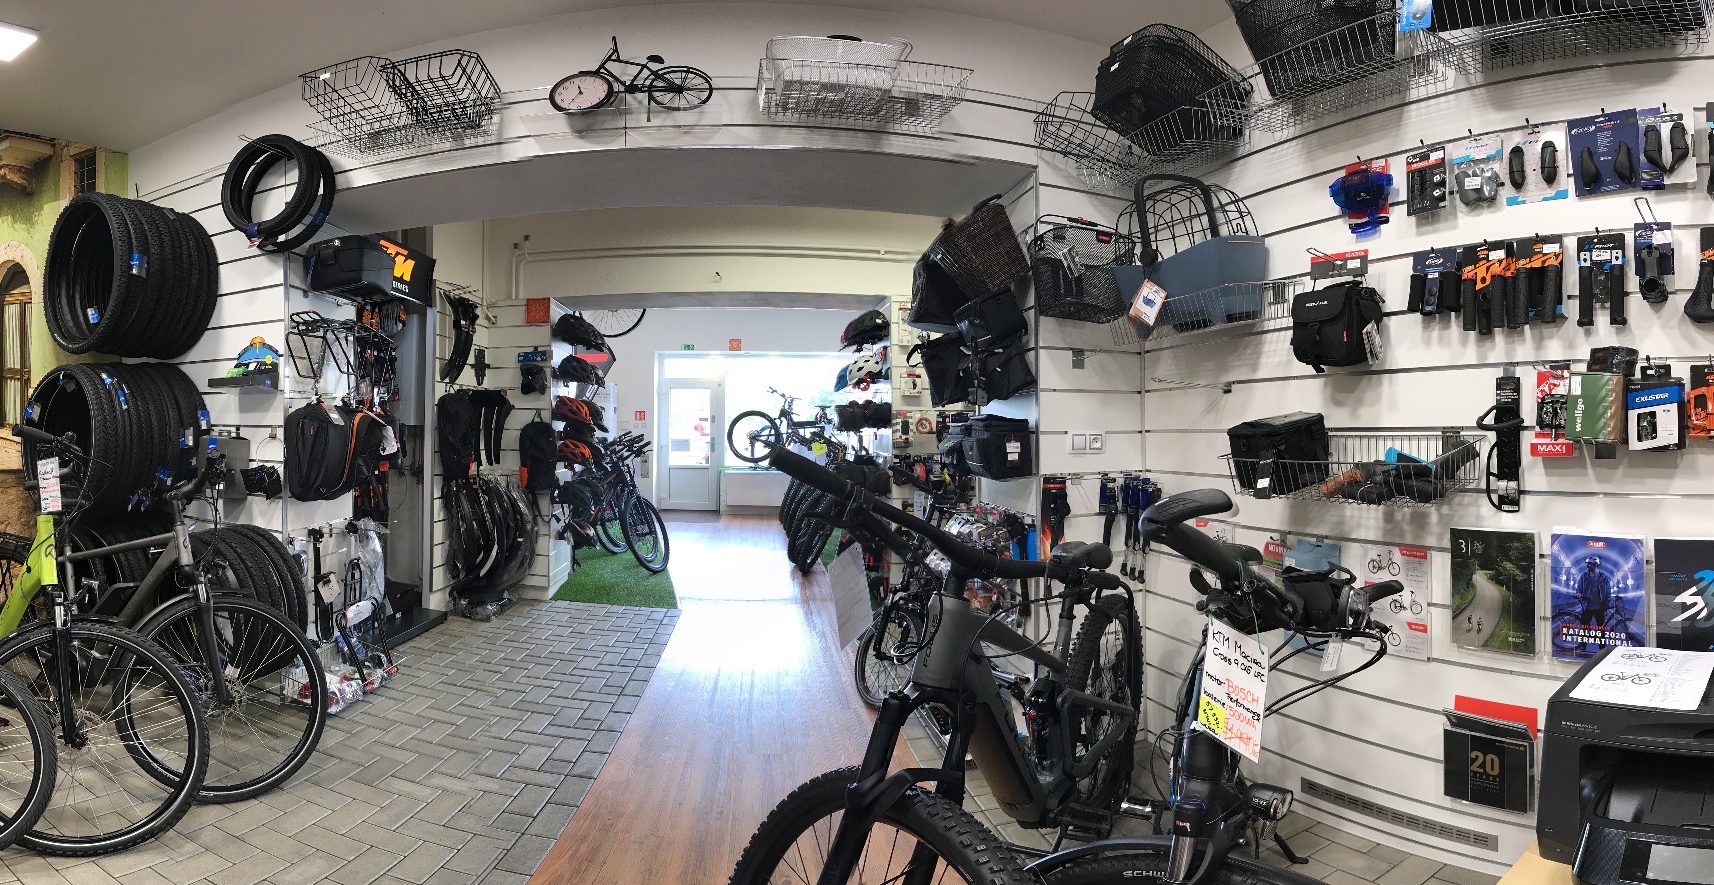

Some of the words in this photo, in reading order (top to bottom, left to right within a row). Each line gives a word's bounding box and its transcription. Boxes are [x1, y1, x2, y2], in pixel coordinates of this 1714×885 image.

[1575, 398, 1585, 432] wellgo
[1537, 444, 1567, 454] MAX1
[1212, 628, 1230, 650] KTM
[1562, 627, 1602, 638] KATALOG
[1604, 631, 1627, 640] 2020
[1562, 634, 1633, 648] INTERNATIONAL
[1212, 647, 1232, 666] Cross
[1225, 677, 1260, 708] BOSCH
[1470, 750, 1500, 776] 20
